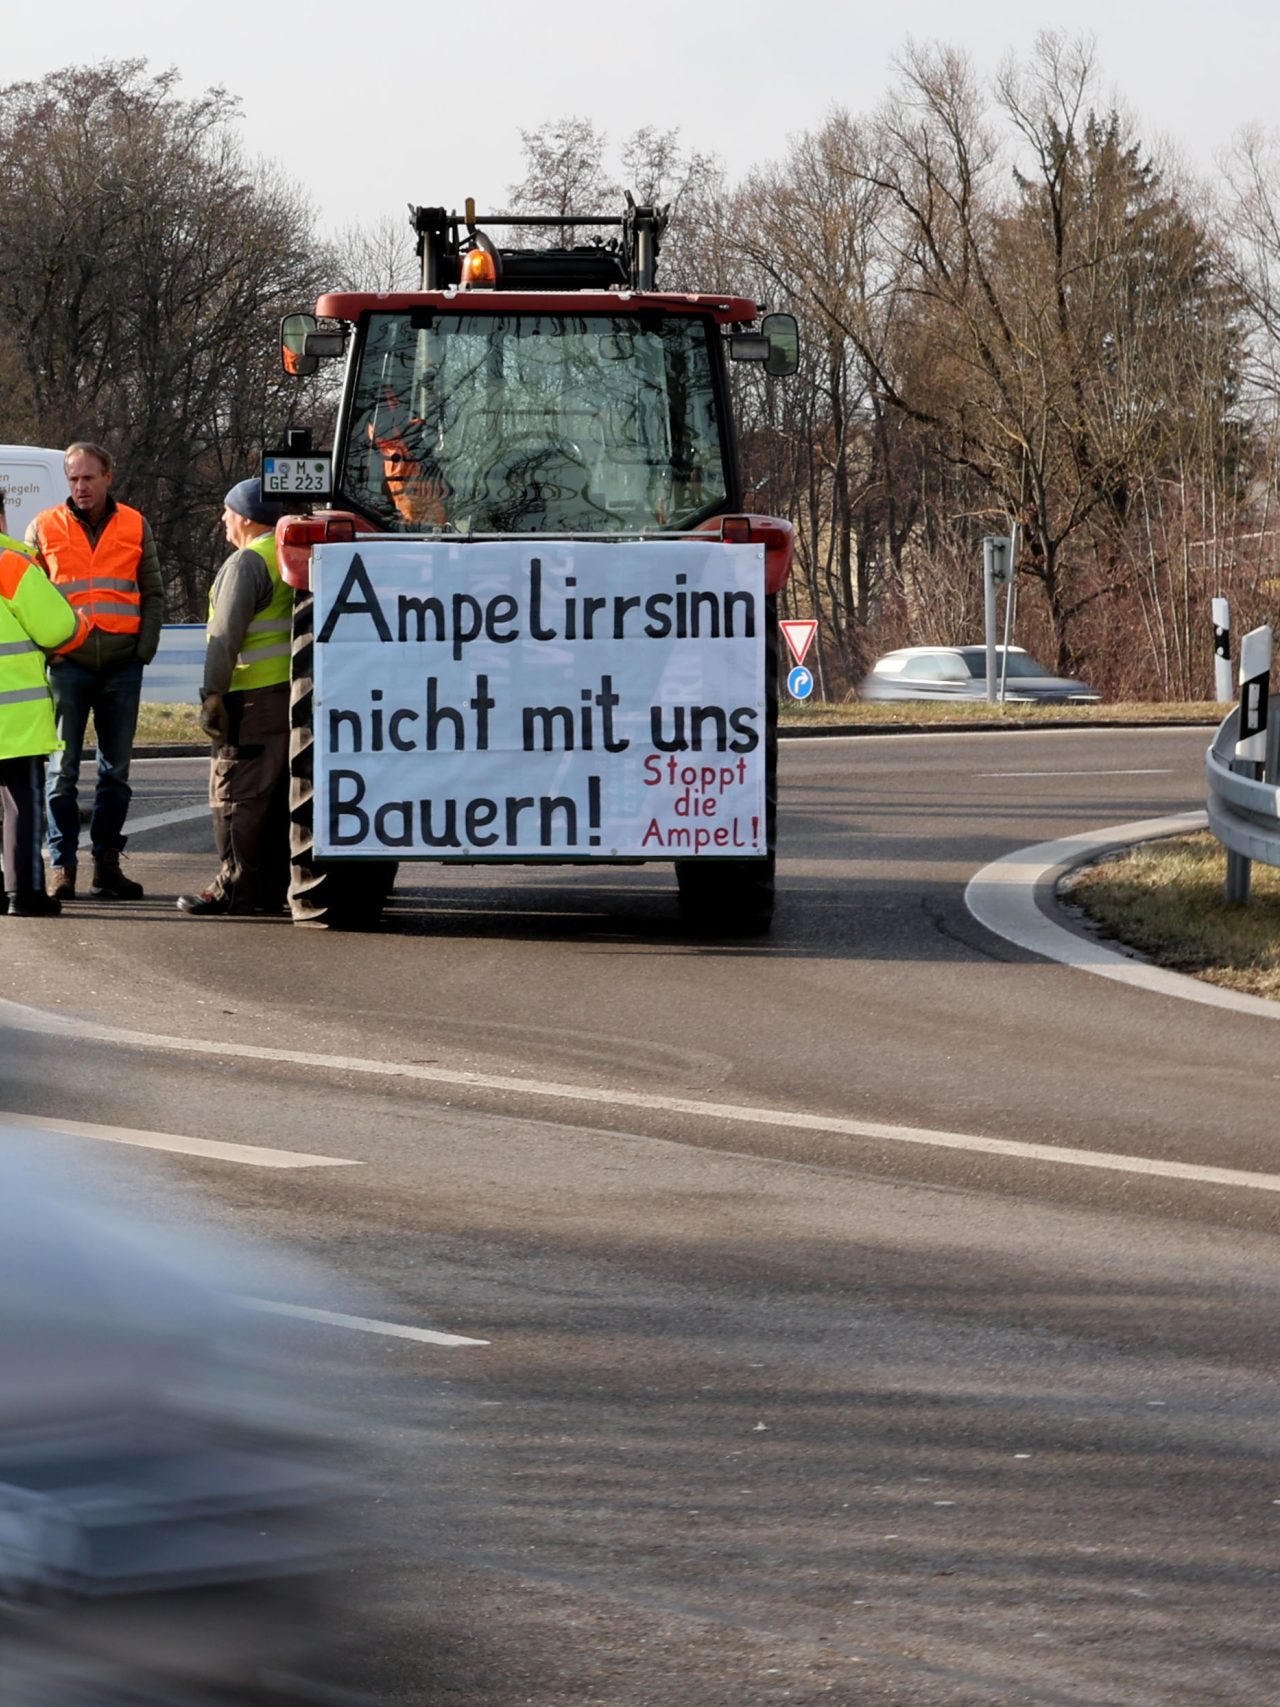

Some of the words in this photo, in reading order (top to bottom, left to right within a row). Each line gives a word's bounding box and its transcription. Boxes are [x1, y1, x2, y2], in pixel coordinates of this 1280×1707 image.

[270, 476, 289, 490] GE
[295, 476, 323, 490] 223
[297, 461, 306, 474] M
[317, 553, 756, 660] Ampelirrsinn
[329, 675, 495, 753] nicht
[523, 675, 630, 753] mit
[651, 706, 759, 753] uns
[643, 754, 747, 795] Stoppt
[329, 769, 601, 847] Bauern!
[674, 787, 717, 817] die
[641, 816, 759, 855] Ampel!
